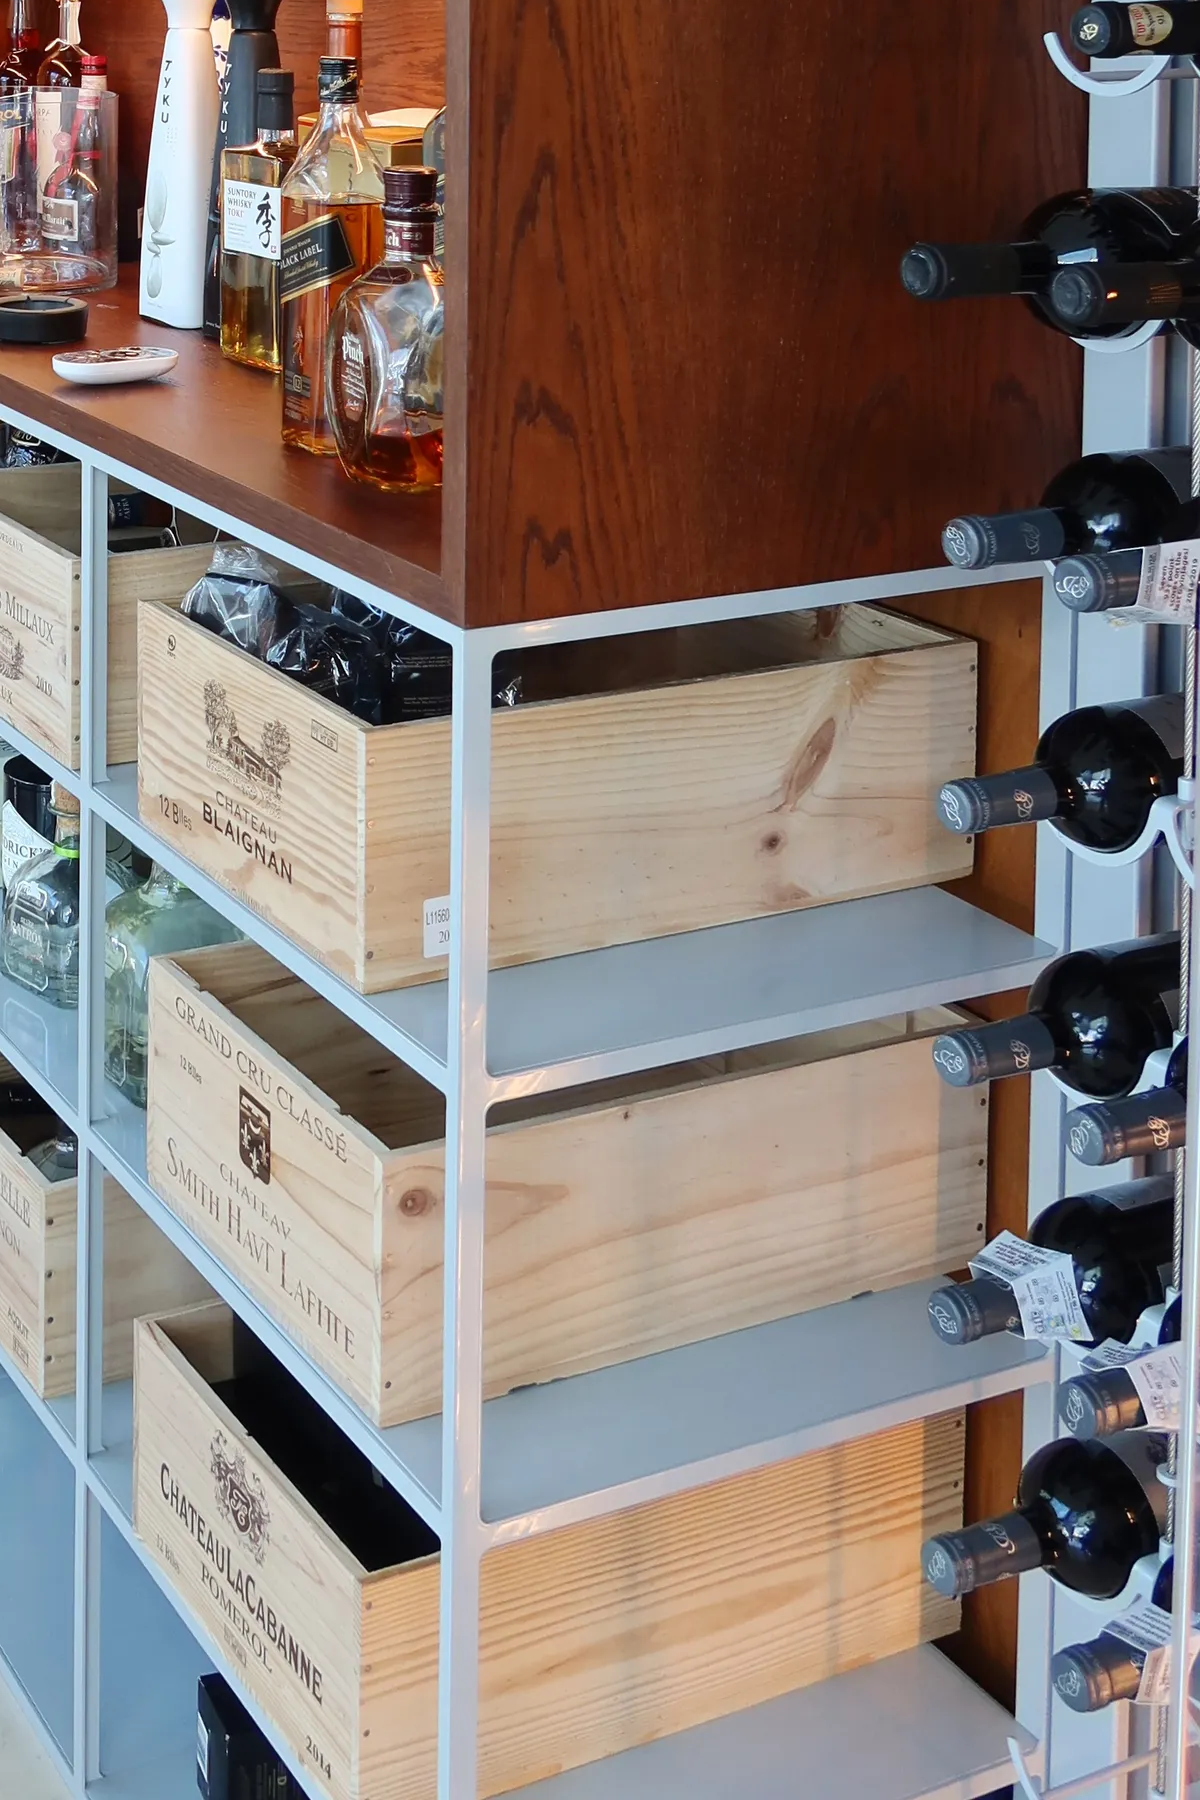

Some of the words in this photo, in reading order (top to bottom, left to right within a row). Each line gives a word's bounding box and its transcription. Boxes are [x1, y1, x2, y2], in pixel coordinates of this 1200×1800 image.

[227, 186, 257, 200] SUNTORY
[227, 196, 253, 209] WHISKY
[227, 207, 242, 219] TOKI
[299, 242, 325, 262] LABEL
[5, 590, 55, 646] MILLAUX
[35, 675, 54, 698] 2019
[158, 793, 171, 818] 12
[215, 789, 278, 845] CHATEAU
[201, 800, 294, 885] BLAIGNAN
[438, 929, 450, 944] 20
[179, 1053, 188, 1070] 12
[175, 995, 232, 1060] GRAND
[235, 1049, 272, 1096] CRU
[276, 1084, 349, 1164] CLASSÉ
[166, 1136, 222, 1224] SMITH
[280, 1248, 356, 1360] LAFITTE
[199, 1560, 273, 1675] POMEROL
[304, 1734, 333, 1781] 2014
